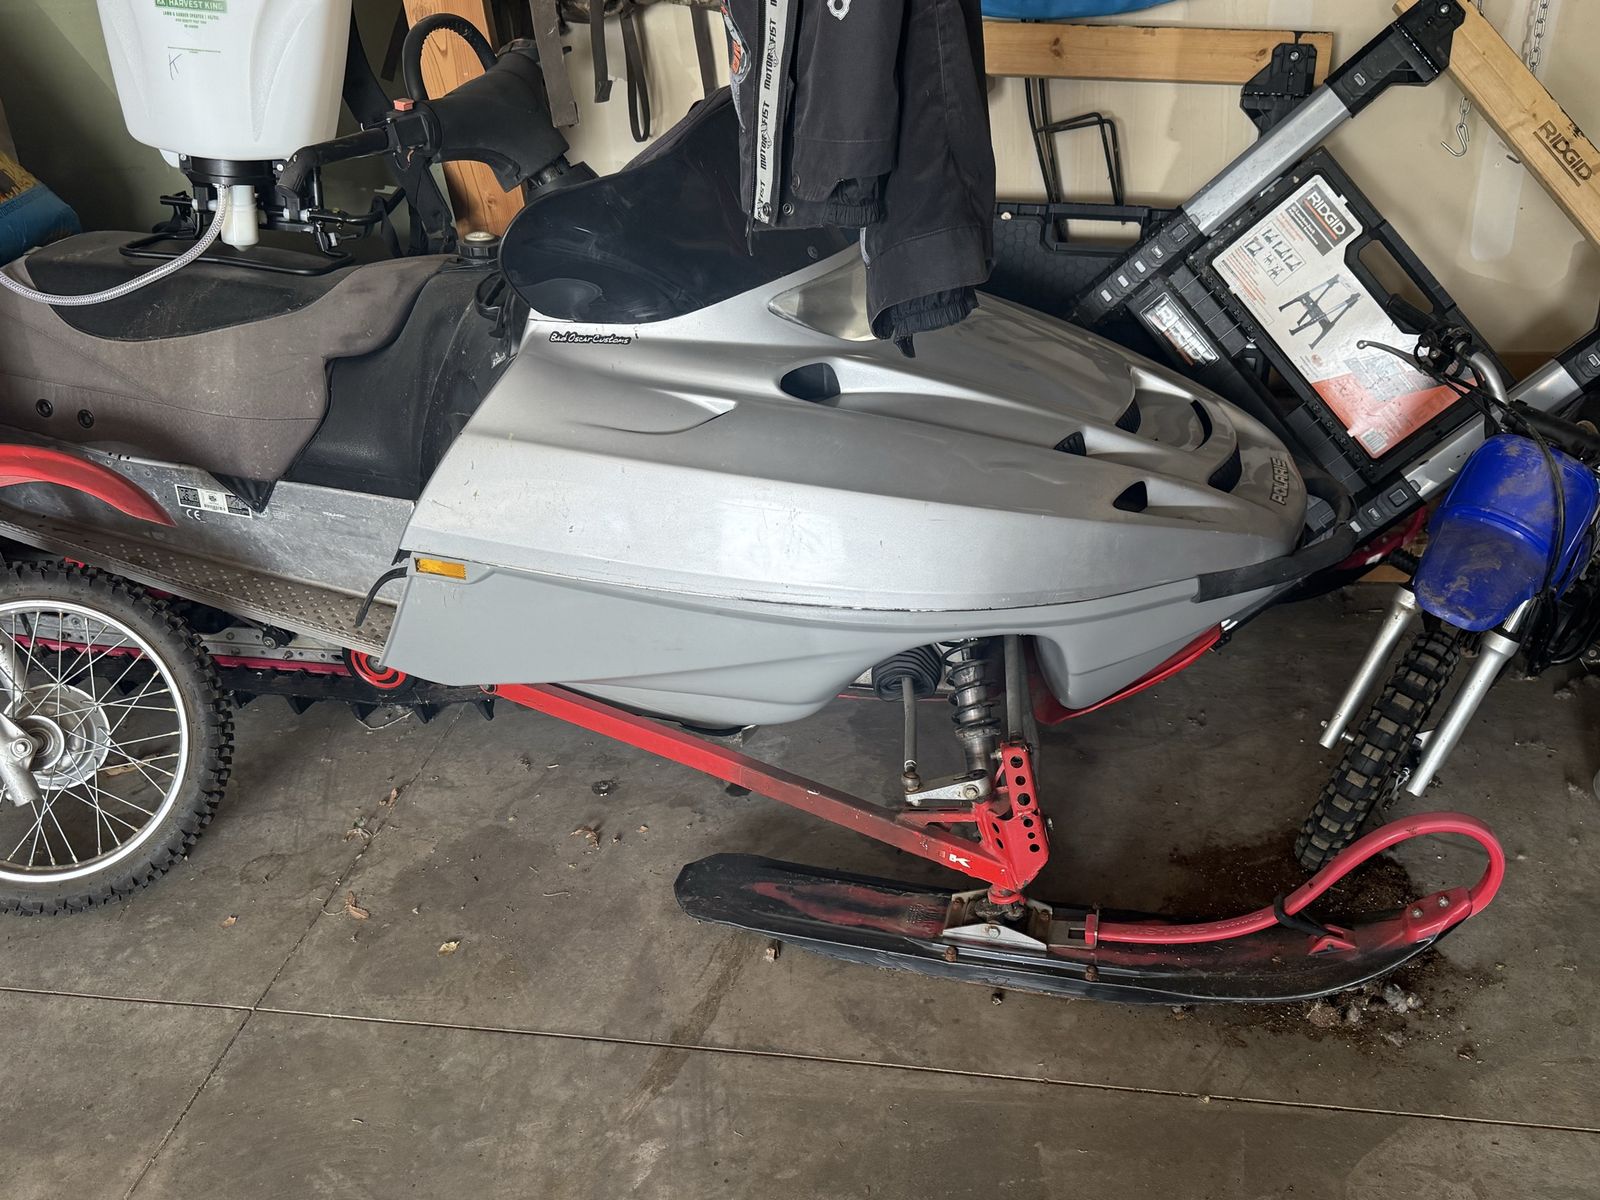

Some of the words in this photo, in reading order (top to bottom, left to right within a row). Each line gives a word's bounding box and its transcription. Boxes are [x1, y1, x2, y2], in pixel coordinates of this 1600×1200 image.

[168, 0, 203, 9] HARVEST
[204, 2, 225, 11] KING
[168, 53, 183, 80] K
[1538, 120, 1593, 180] RIDGID
[1306, 191, 1346, 235] RIDGID
[1269, 456, 1289, 506] POLARIS
